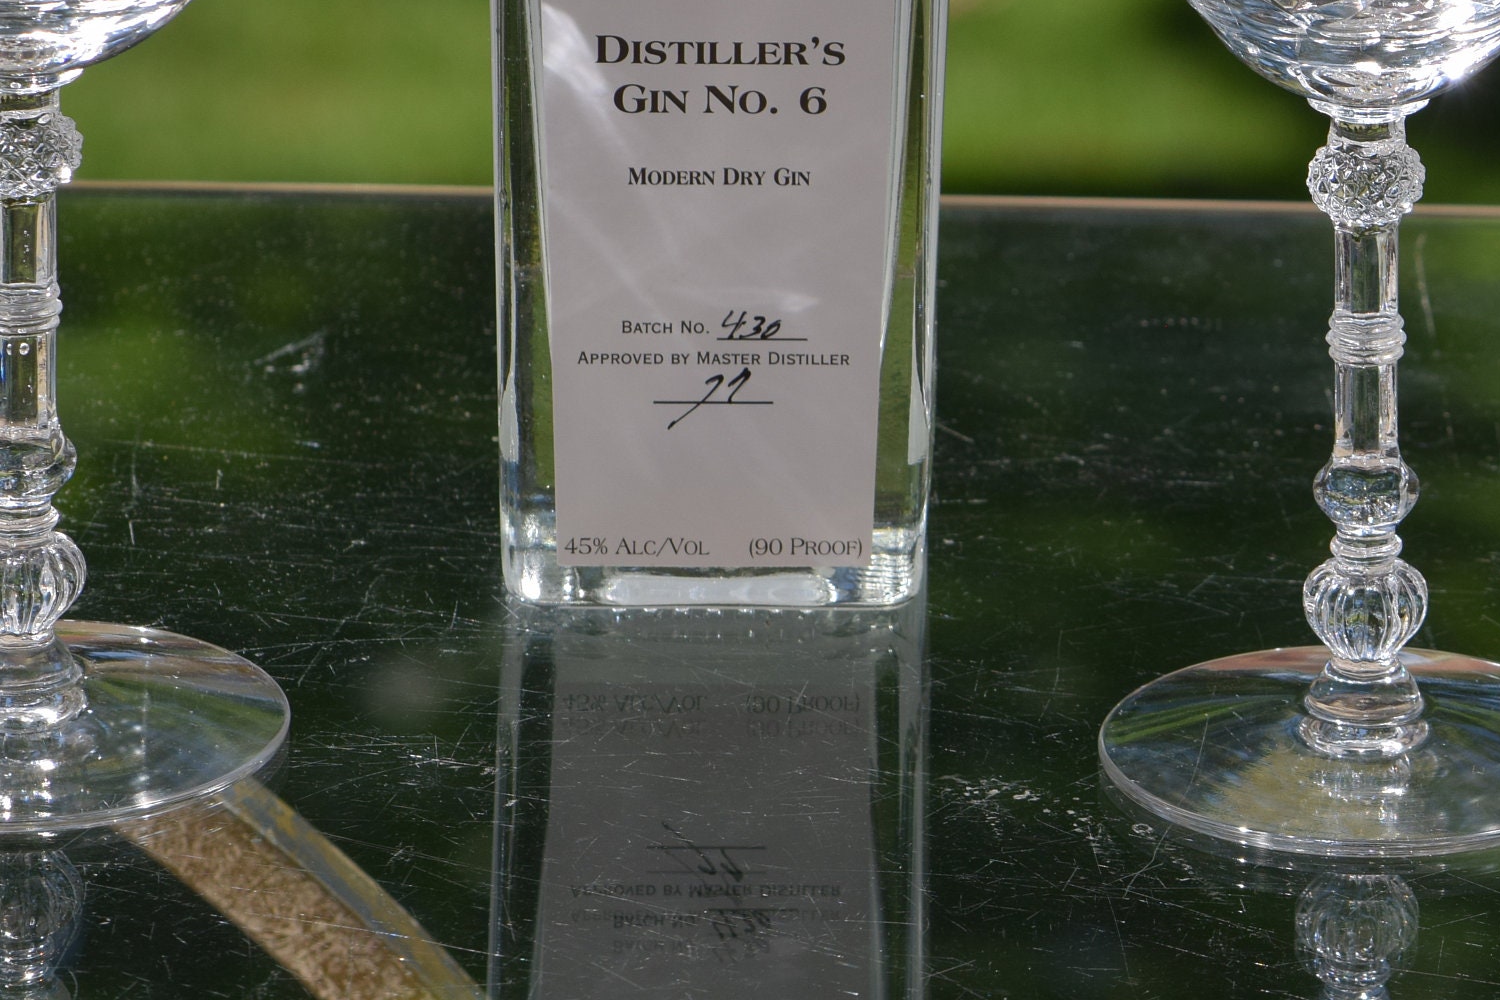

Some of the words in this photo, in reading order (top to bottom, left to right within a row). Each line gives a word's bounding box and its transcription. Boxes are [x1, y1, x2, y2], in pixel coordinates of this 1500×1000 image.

[595, 34, 846, 66] DISTILLER'S
[613, 83, 689, 114] GIN
[703, 85, 778, 115] NO.
[799, 86, 828, 115] 6
[628, 167, 716, 186] MODERN
[723, 167, 766, 186] DRY
[773, 167, 811, 187] GIN
[622, 320, 673, 334] BATCH
[680, 320, 710, 334] NO.
[721, 310, 782, 339] 430
[577, 350, 664, 365] APPROVED
[671, 353, 690, 365] BY
[697, 351, 761, 366] MASTER
[768, 351, 850, 366] DISTILLER
[564, 537, 608, 555] 45%
[615, 537, 710, 557] ALC/VOL
[749, 538, 783, 557] (90
[790, 538, 863, 557] PROOF)
